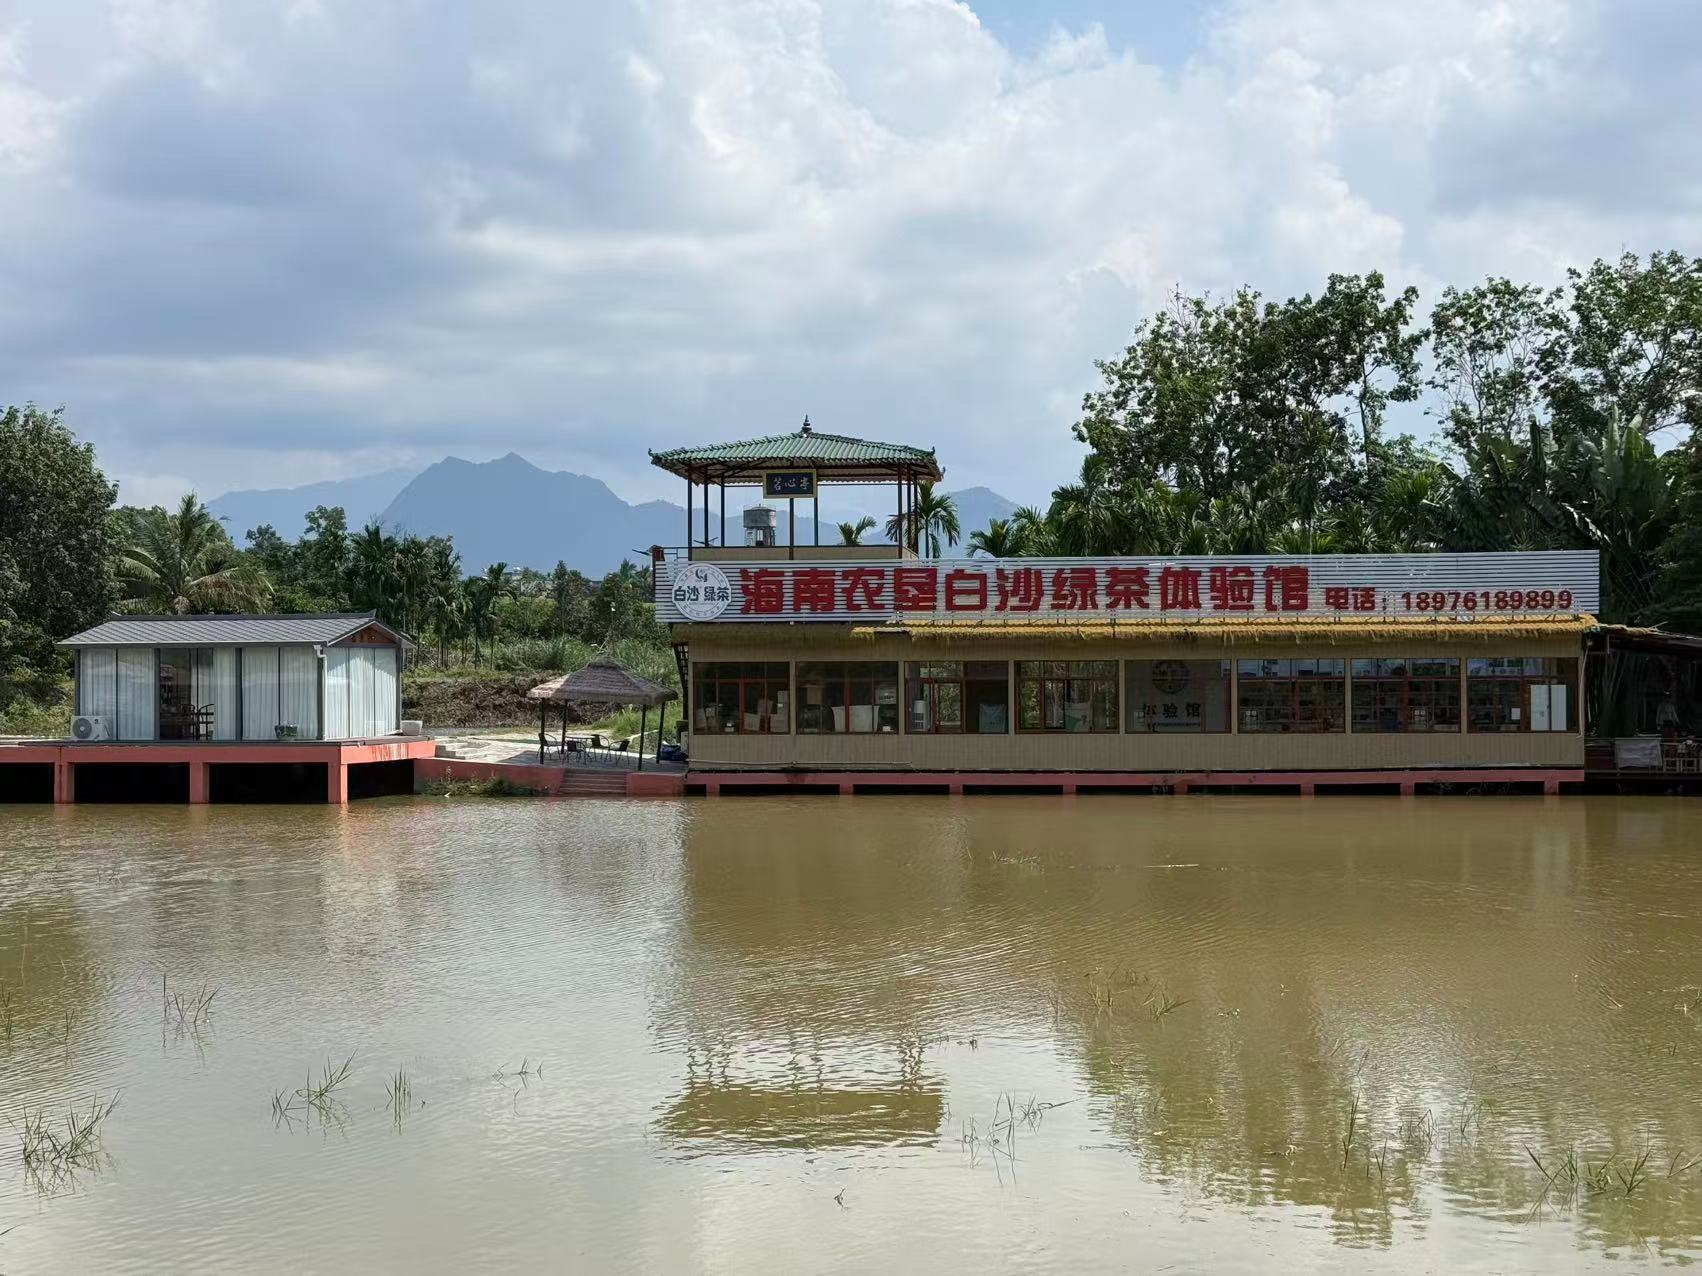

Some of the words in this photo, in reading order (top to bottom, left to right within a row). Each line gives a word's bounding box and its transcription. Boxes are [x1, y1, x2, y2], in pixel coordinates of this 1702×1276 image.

[674, 586, 700, 601] 白沙
[704, 586, 730, 601] 绿茶
[740, 566, 1308, 613] 海南农垦白沙绿茶体验馆
[1402, 590, 1572, 611] 18976189899
